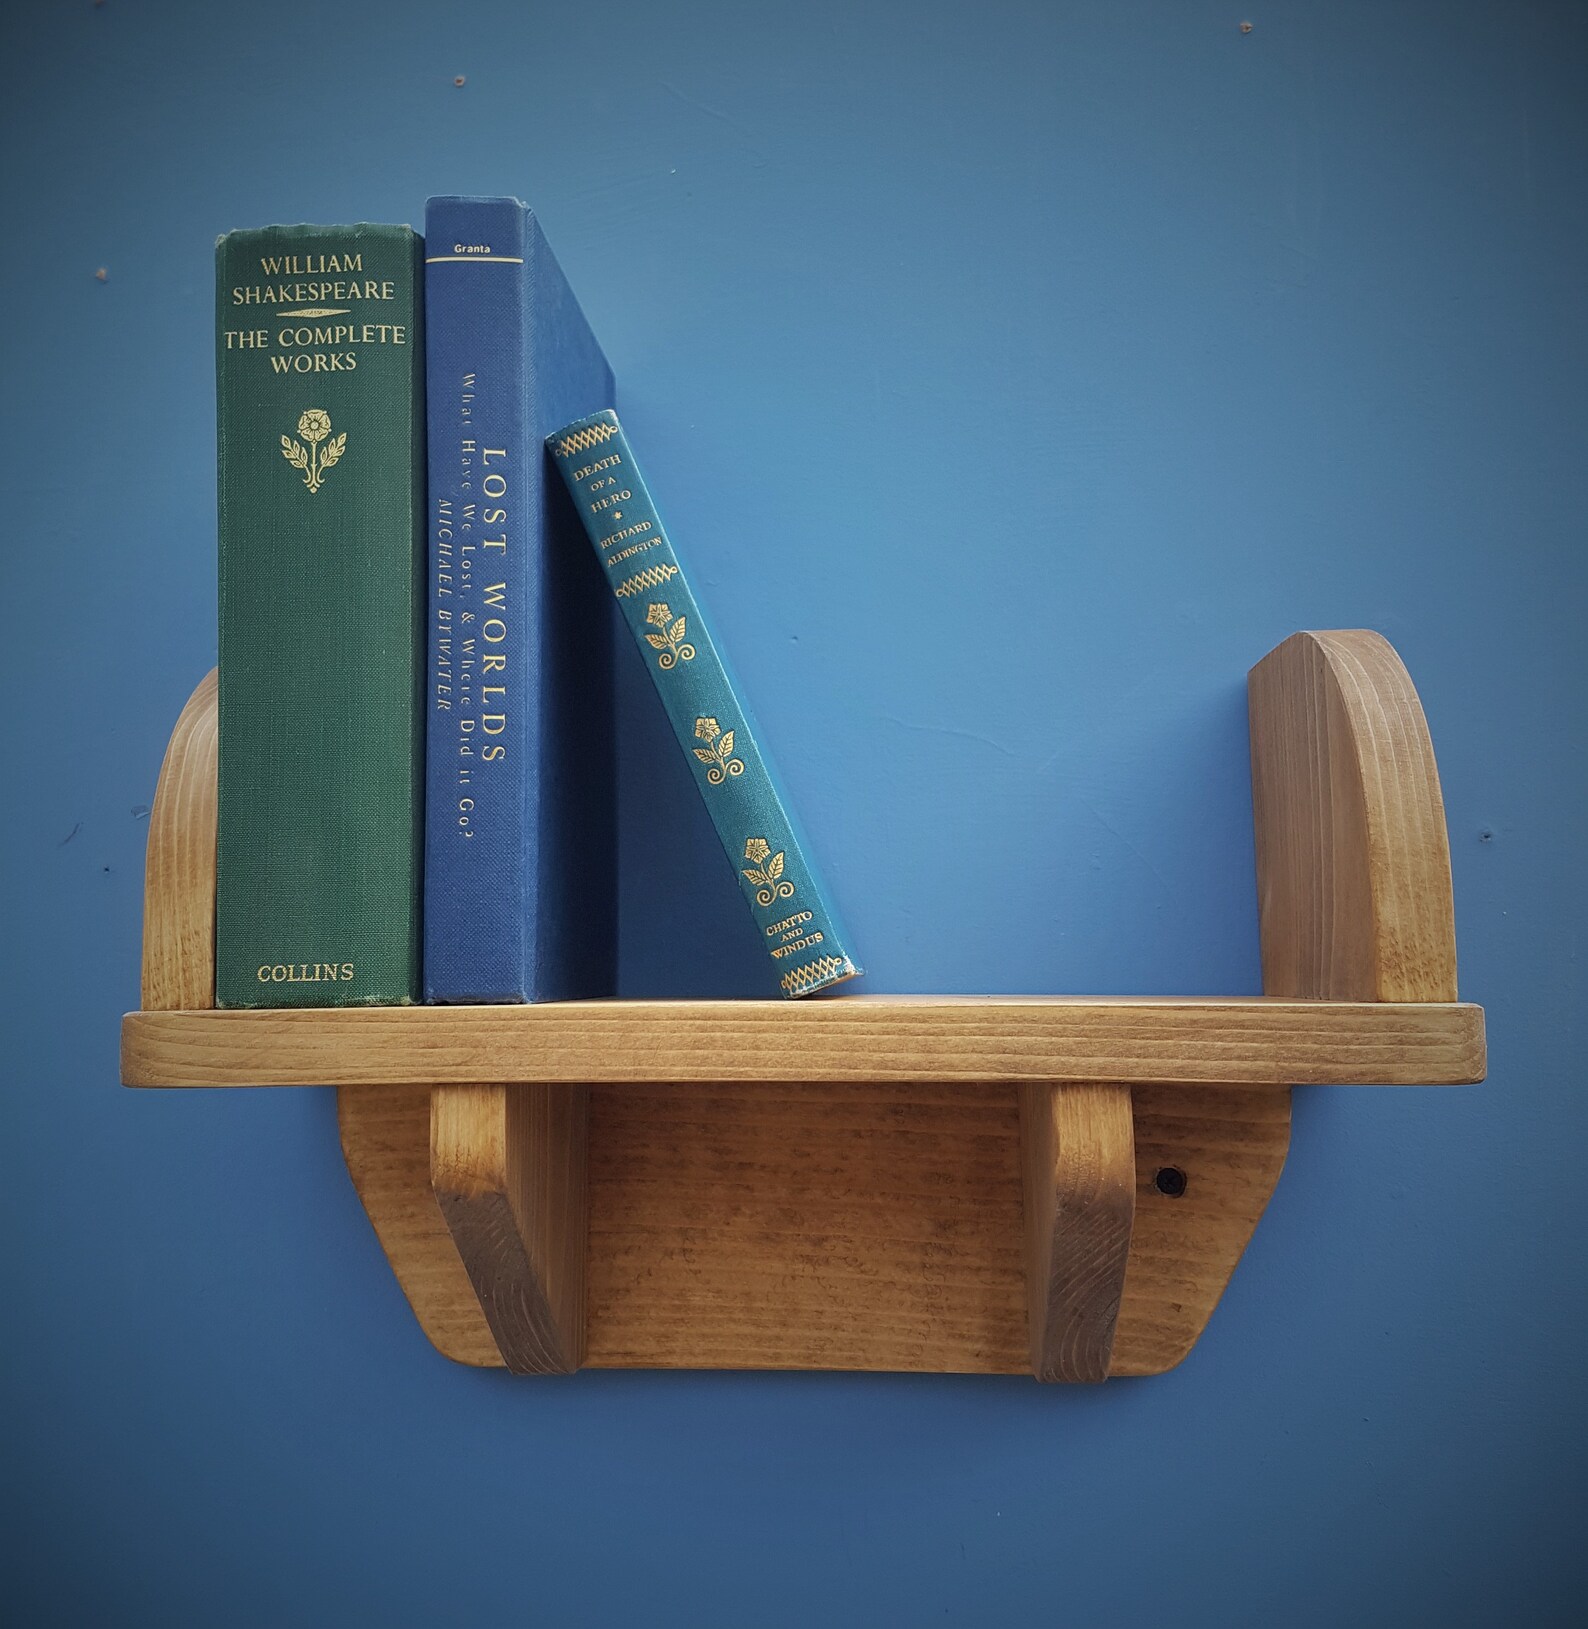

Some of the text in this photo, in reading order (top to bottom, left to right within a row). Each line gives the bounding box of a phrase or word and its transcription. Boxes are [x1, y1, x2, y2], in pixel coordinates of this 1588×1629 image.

[454, 244, 491, 253] Granta
[261, 253, 364, 276] WILLIAM
[233, 281, 396, 305] SHAKESPEARE
[224, 324, 406, 350] THE COMPLETE
[271, 352, 358, 374] WORKS
[461, 372, 477, 425] What
[461, 439, 477, 490] Have
[573, 454, 622, 482] DEATH
[590, 475, 617, 493] OF A
[591, 489, 632, 514] HERO
[461, 503, 477, 532] We
[600, 520, 652, 550] RICHARD
[607, 536, 663, 568] ALDINGTON
[459, 545, 477, 600] Lost,
[437, 498, 453, 711] MICHAEL BYWATER
[461, 611, 476, 625] &
[481, 448, 508, 762] LOST WORLDS
[461, 638, 476, 705] Where
[460, 719, 475, 756] Did
[459, 798, 475, 838] Go?
[766, 910, 813, 936] CHATTO
[781, 927, 804, 943] AND
[770, 931, 824, 960] WINDUS
[257, 962, 354, 983] COLLINS
